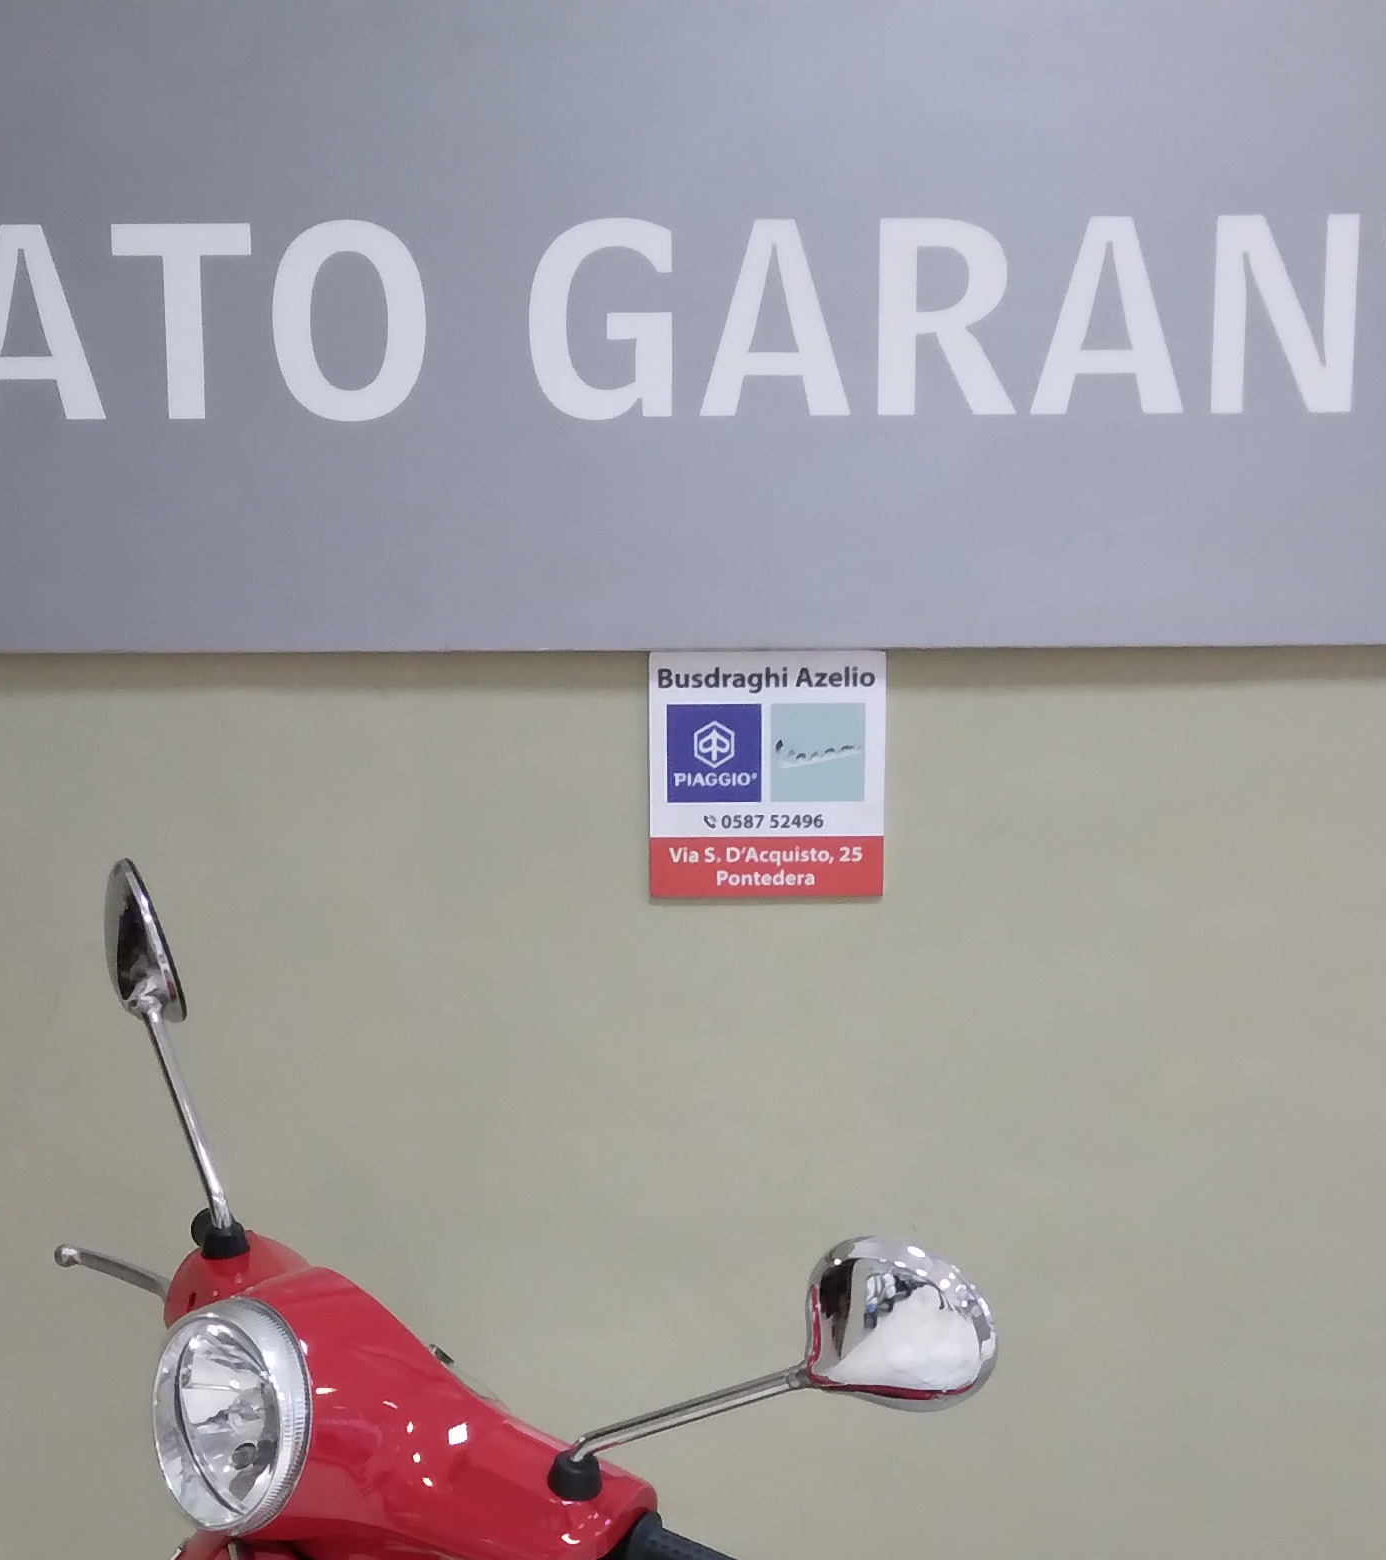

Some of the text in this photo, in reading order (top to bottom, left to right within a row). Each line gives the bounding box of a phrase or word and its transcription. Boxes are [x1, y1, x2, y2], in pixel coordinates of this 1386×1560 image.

[657, 666, 876, 694] Busdraghi Azelio
[673, 772, 749, 787] PIAGGIO
[721, 813, 824, 829] 0587 52496
[668, 846, 700, 864] Via
[704, 846, 722, 864] S.
[839, 846, 863, 863] 25
[716, 868, 815, 886] Pontedera
